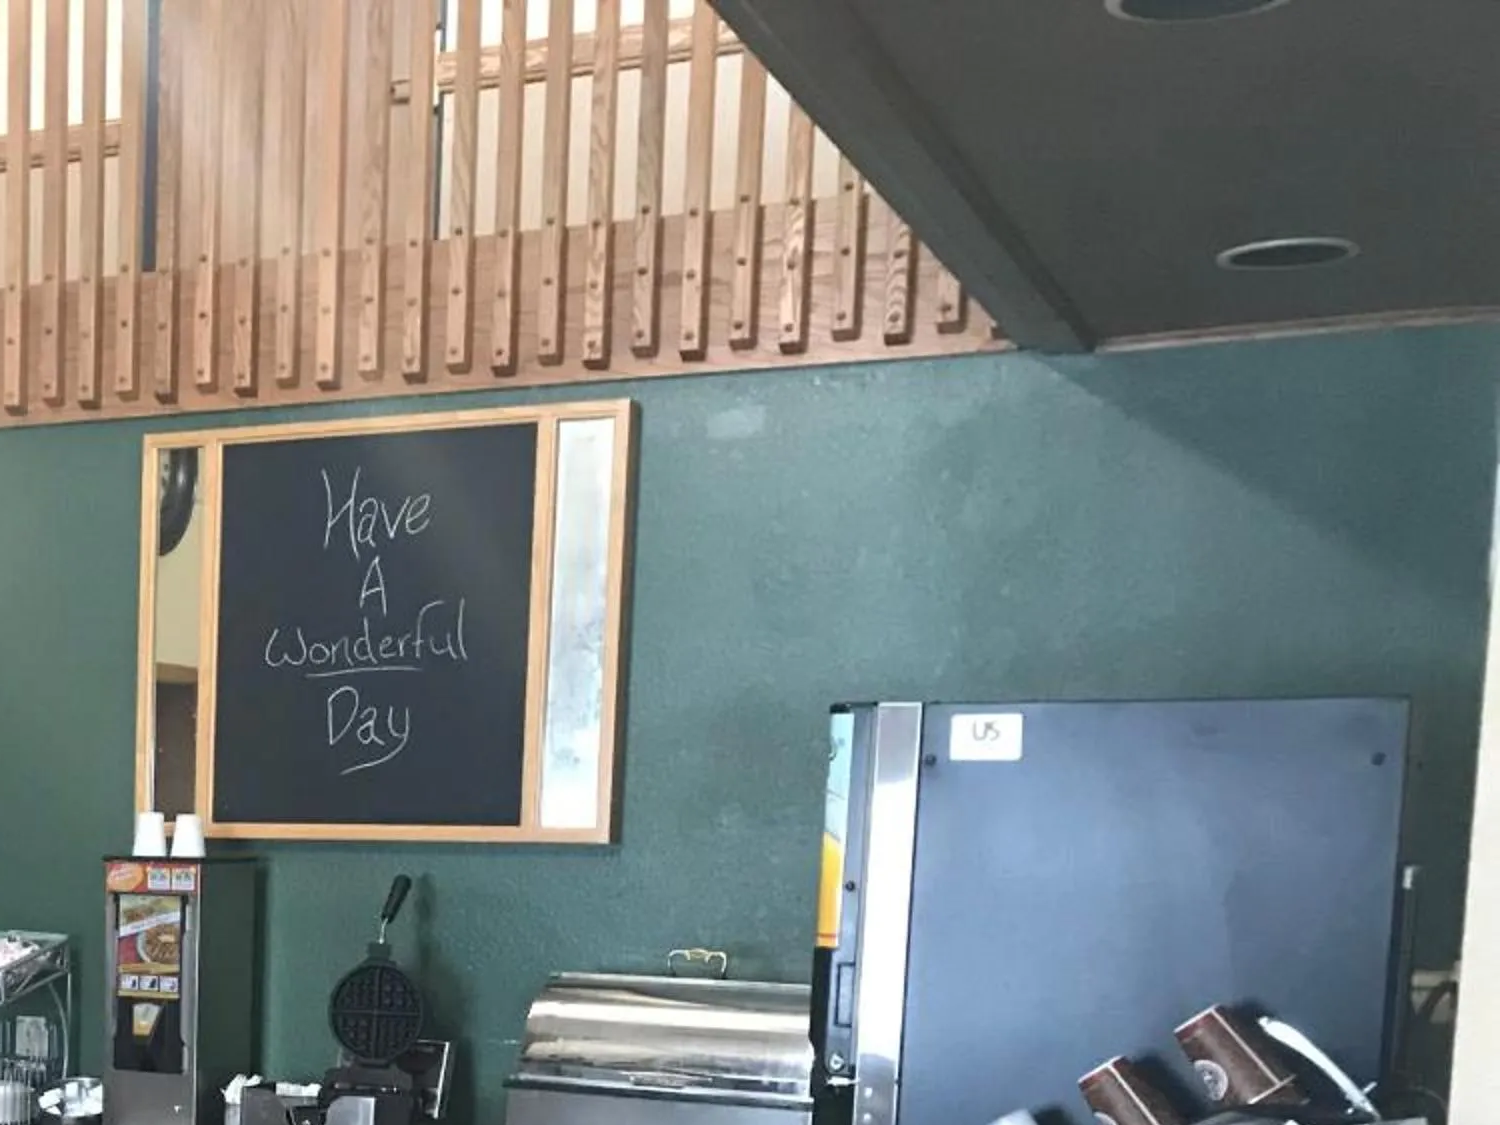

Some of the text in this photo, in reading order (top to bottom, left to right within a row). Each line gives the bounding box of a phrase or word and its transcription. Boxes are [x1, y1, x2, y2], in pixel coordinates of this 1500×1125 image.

[321, 466, 431, 561] Have
[359, 555, 387, 616] A
[264, 598, 468, 668] Wonderful
[326, 686, 411, 775] Day
